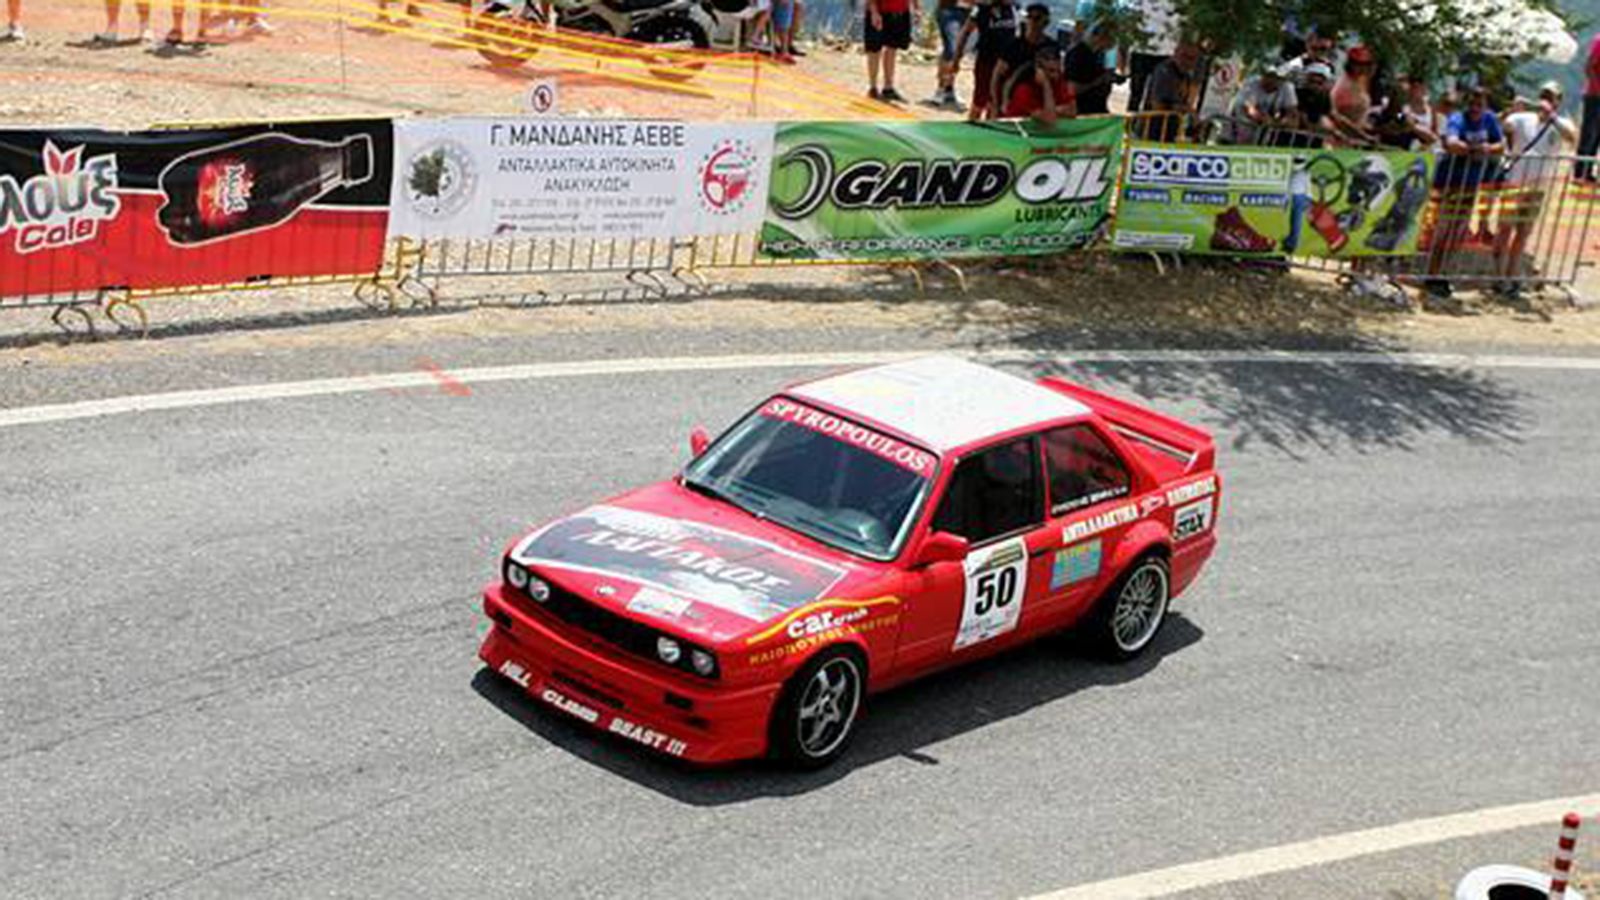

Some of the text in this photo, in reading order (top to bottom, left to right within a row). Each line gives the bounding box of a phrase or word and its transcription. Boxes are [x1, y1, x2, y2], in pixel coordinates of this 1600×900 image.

[509, 125, 627, 147] ΜΑΝΔΑΝΗΣ
[632, 125, 685, 147] ΑΕΒΕ
[1134, 153, 1285, 178] sparco club
[832, 158, 1111, 208] GAND OIL
[18, 216, 96, 248] Cola
[769, 401, 931, 470] SPYROPOULOS
[974, 566, 1017, 616] 50
[787, 611, 834, 639] car
[608, 717, 668, 748] BEAST
